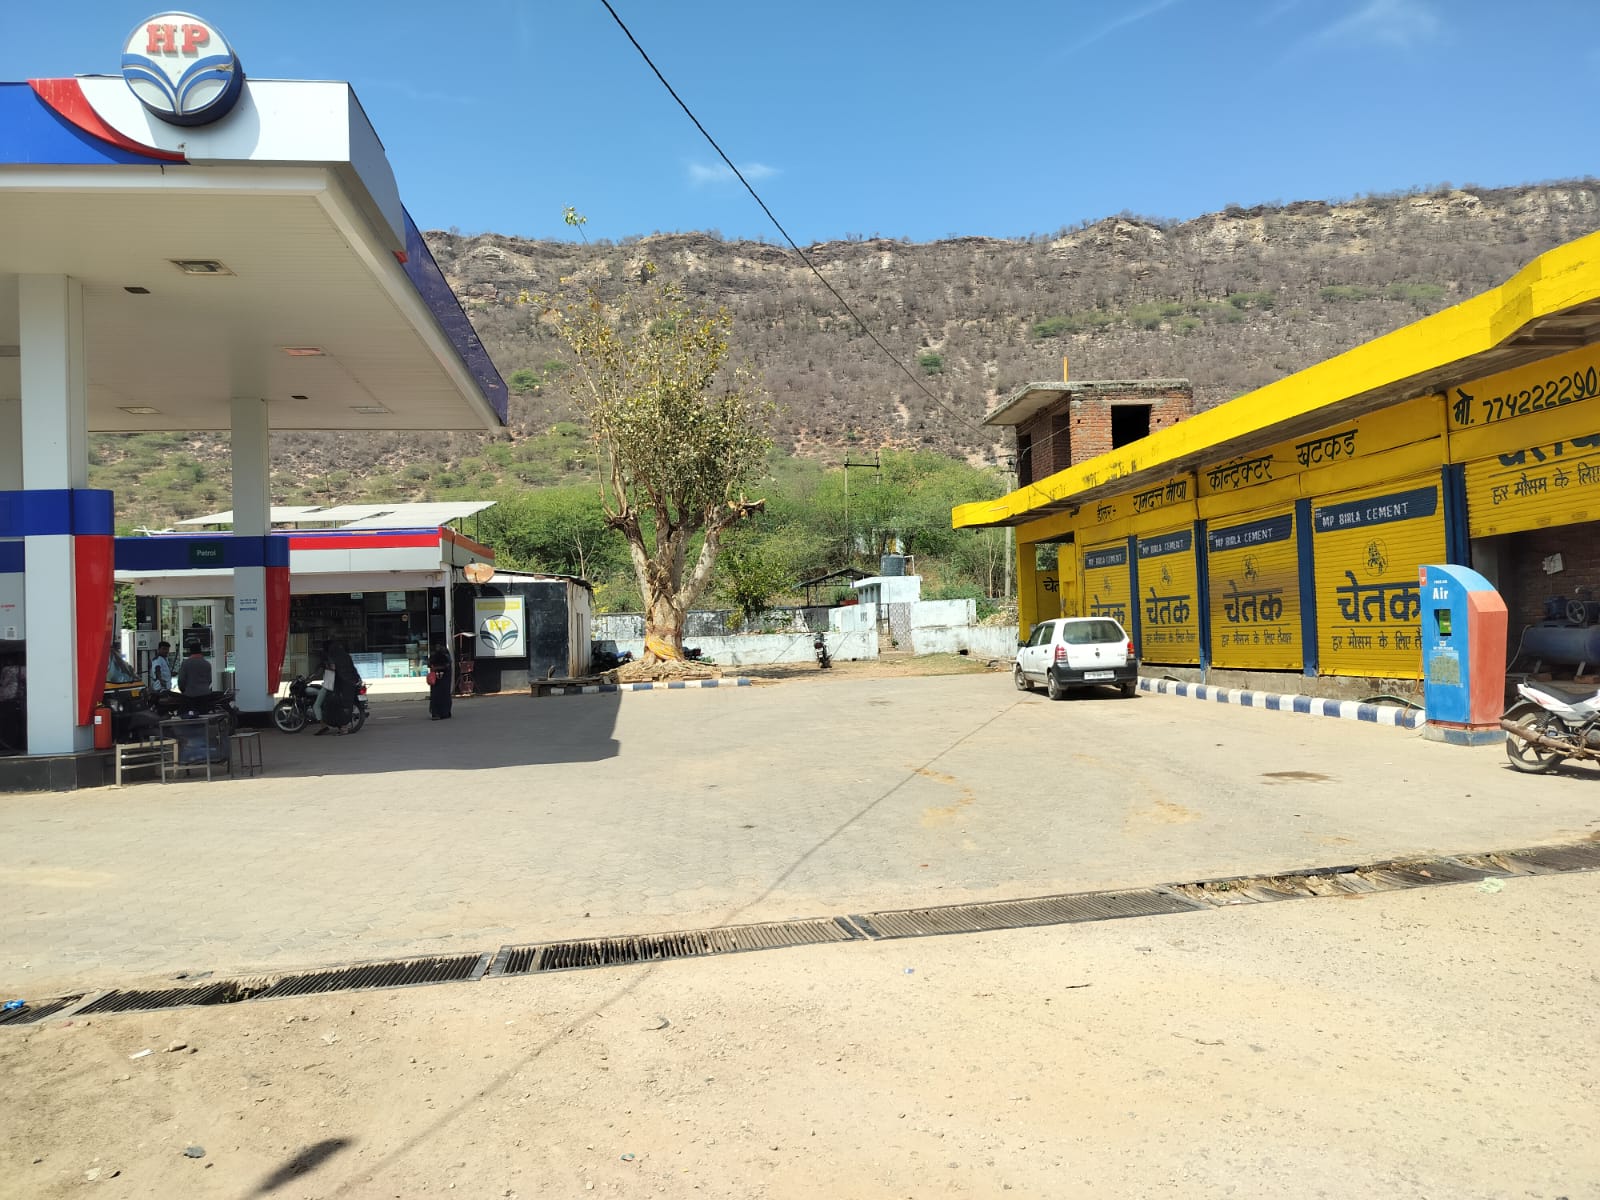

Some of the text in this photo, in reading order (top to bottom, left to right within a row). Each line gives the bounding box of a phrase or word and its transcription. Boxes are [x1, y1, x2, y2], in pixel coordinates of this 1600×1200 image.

[146, 23, 210, 53] HP
[1482, 365, 1600, 423] 774222290
[1490, 485, 1508, 504] हर
[1514, 472, 1547, 496] मौसम
[1553, 467, 1572, 488] के
[1322, 515, 1335, 527] MP
[1339, 510, 1361, 525] BIRLA
[1366, 502, 1409, 520] CEMENT
[1244, 527, 1273, 543] CEMENT
[196, 548, 216, 557] Petrol
[1146, 587, 1190, 624] चेतक
[1223, 580, 1283, 623] चेतक
[1336, 570, 1421, 622] चेतक
[1432, 586, 1449, 600] Air
[1331, 635, 1343, 651] हर
[1377, 630, 1388, 649] के
[1394, 630, 1411, 649] लिए
